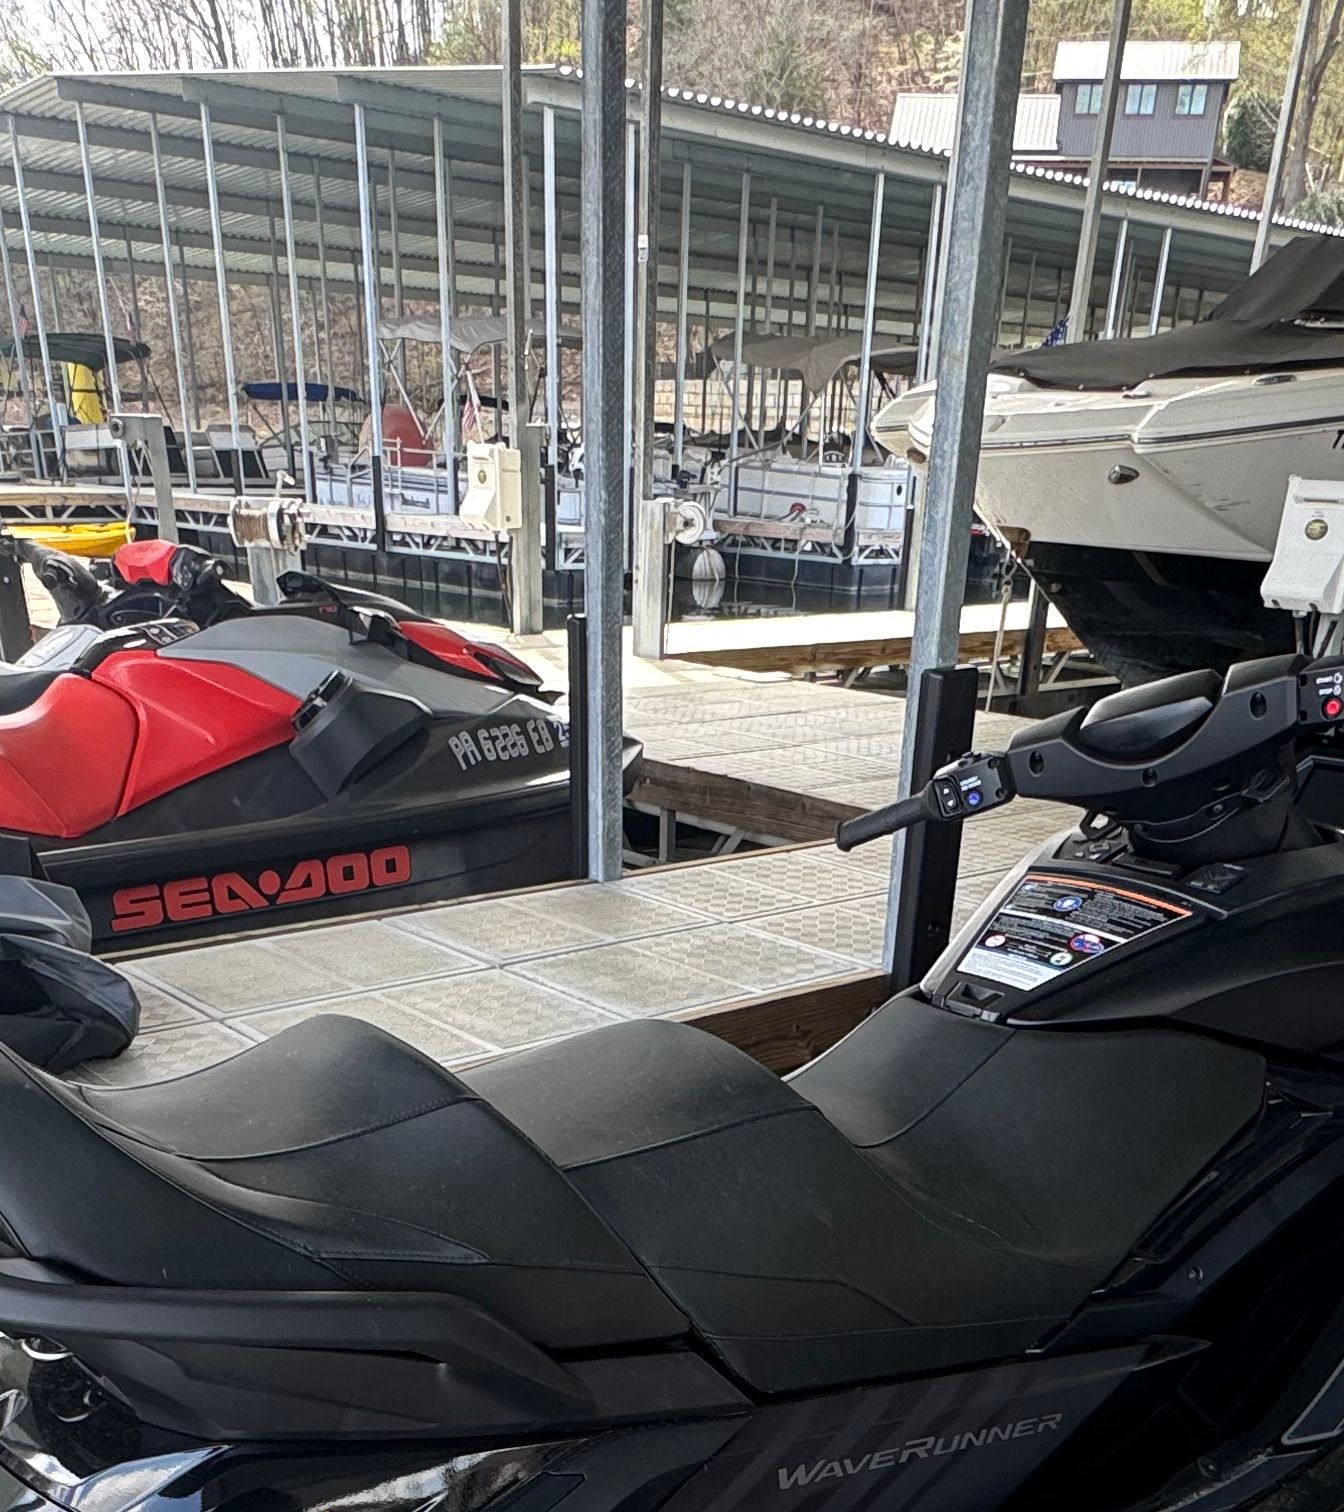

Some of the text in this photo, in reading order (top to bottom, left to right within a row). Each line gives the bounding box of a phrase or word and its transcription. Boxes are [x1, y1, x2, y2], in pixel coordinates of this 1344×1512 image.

[448, 731, 482, 770] PA
[526, 719, 554, 754] EB
[777, 1413, 1062, 1490] WAVERUNNER
